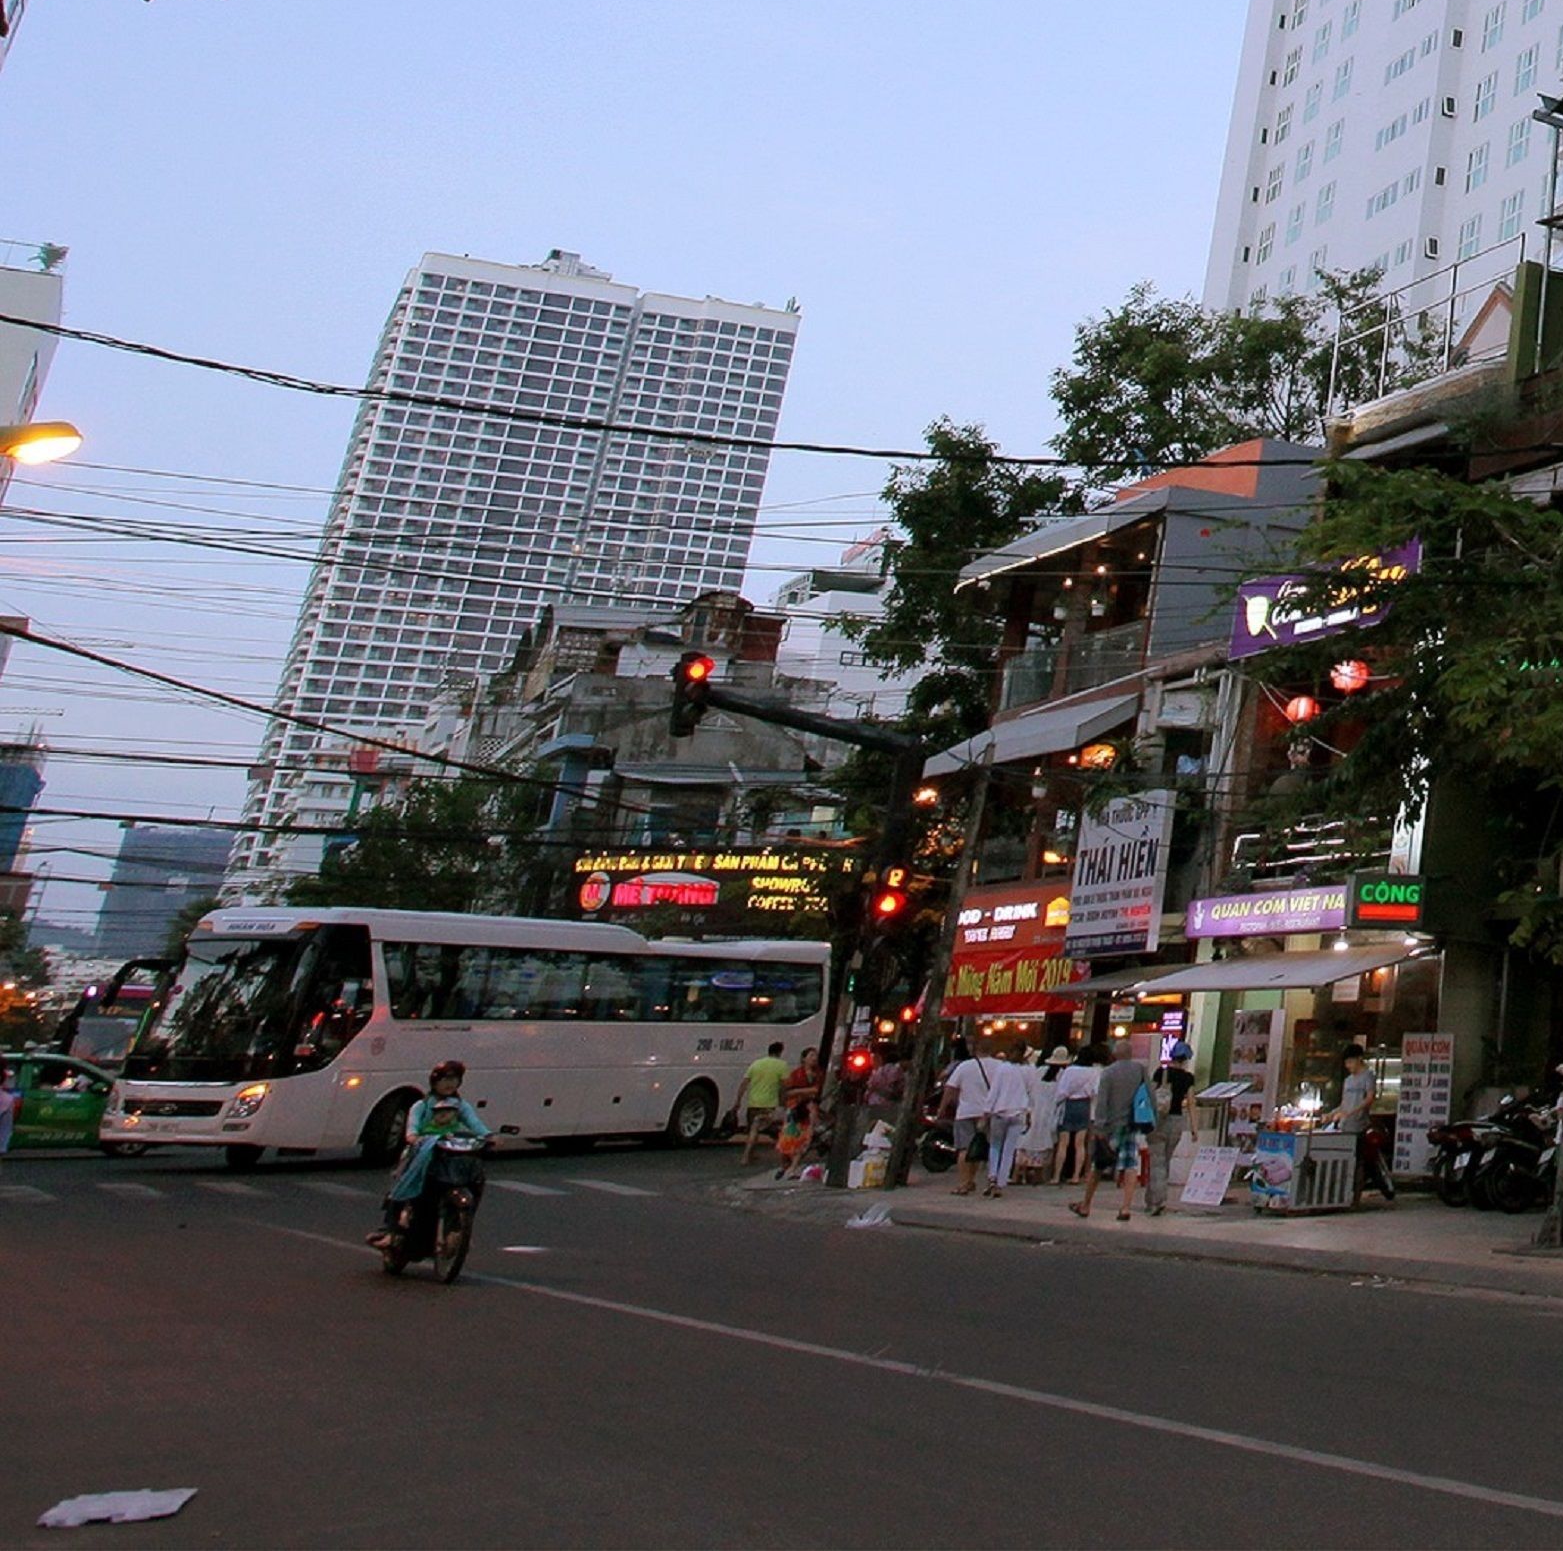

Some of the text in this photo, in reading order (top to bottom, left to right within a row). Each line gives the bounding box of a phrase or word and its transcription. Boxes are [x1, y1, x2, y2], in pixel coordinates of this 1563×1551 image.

[1078, 836, 1116, 886] THÁI
[1322, 894, 1345, 911] NA
[1360, 881, 1422, 905] CỘNG
[993, 902, 1039, 923] DRINK
[1039, 957, 1073, 992] 2019
